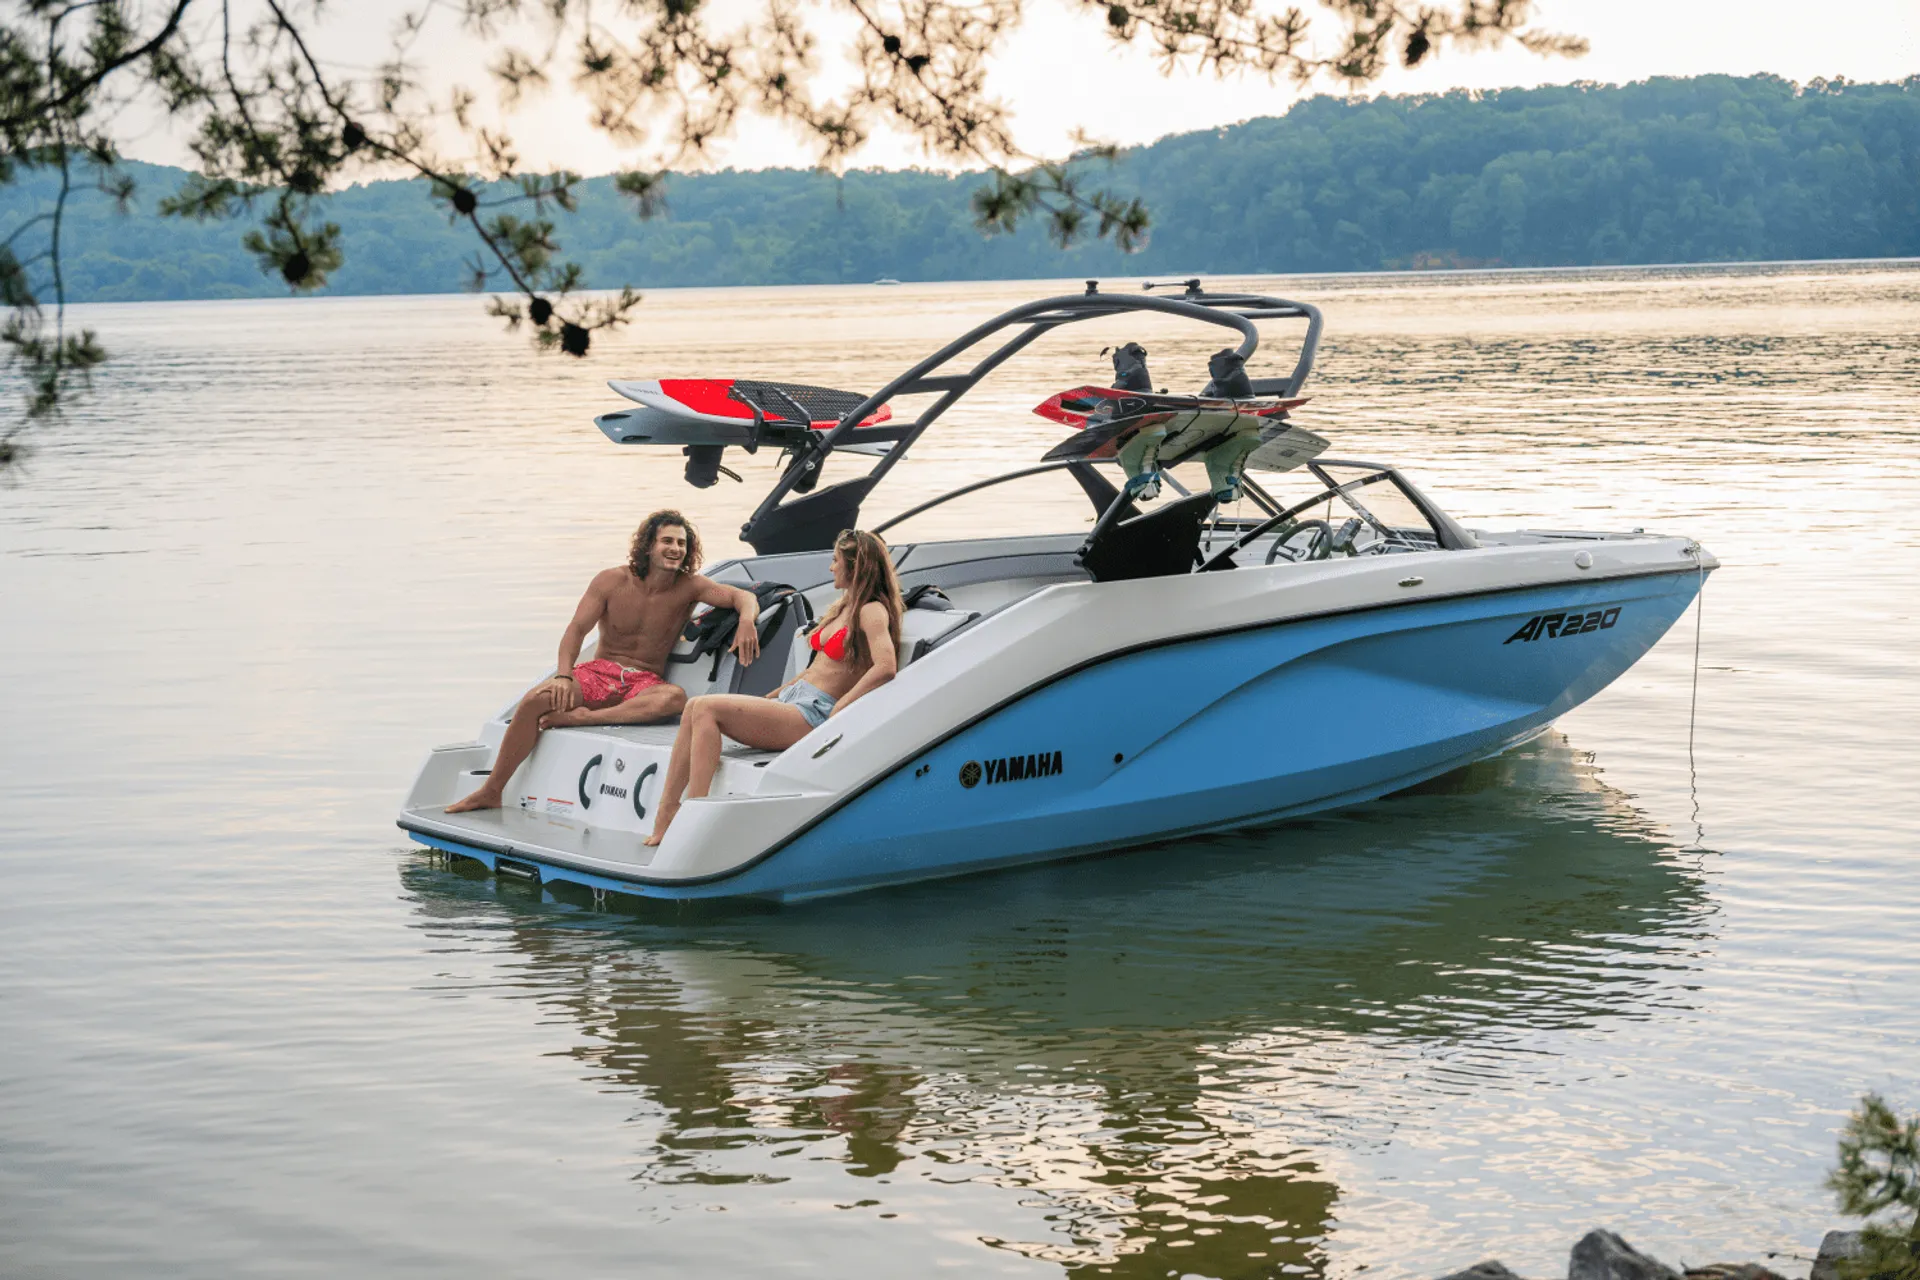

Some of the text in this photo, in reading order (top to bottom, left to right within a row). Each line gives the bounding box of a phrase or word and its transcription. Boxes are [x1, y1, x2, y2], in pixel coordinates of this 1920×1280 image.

[1502, 606, 1622, 645] AR220
[984, 750, 1063, 785] YAMAHA
[604, 784, 628, 800] YAMAHA
